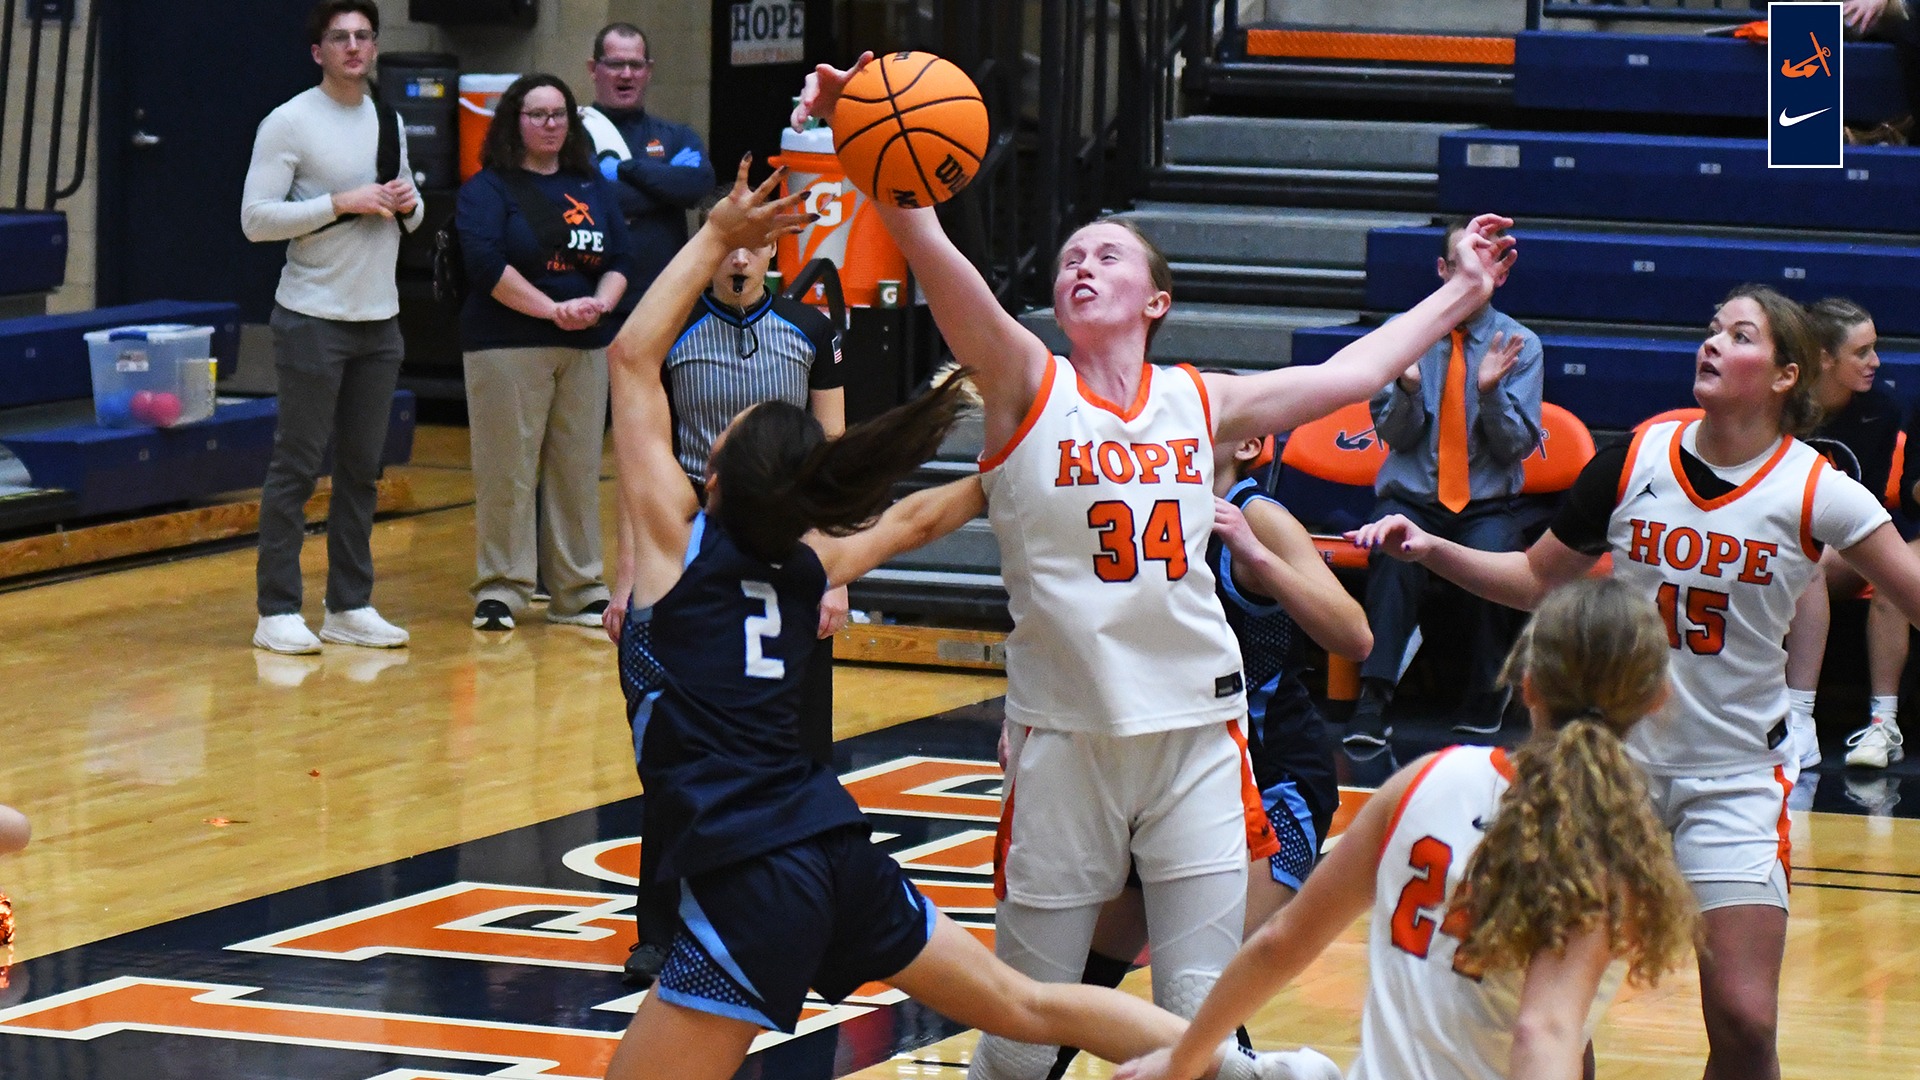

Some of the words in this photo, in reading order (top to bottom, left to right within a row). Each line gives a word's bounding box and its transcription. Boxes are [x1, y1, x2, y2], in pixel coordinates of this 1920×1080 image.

[731, 4, 804, 41] HOPE
[805, 181, 842, 227] G
[567, 229, 604, 252] OPE
[883, 286, 898, 304] G
[1055, 438, 1203, 487] HOPE
[1087, 499, 1189, 583] 34
[1628, 518, 1779, 586] HOPE
[741, 580, 785, 680] 2
[1655, 581, 1729, 655] 15
